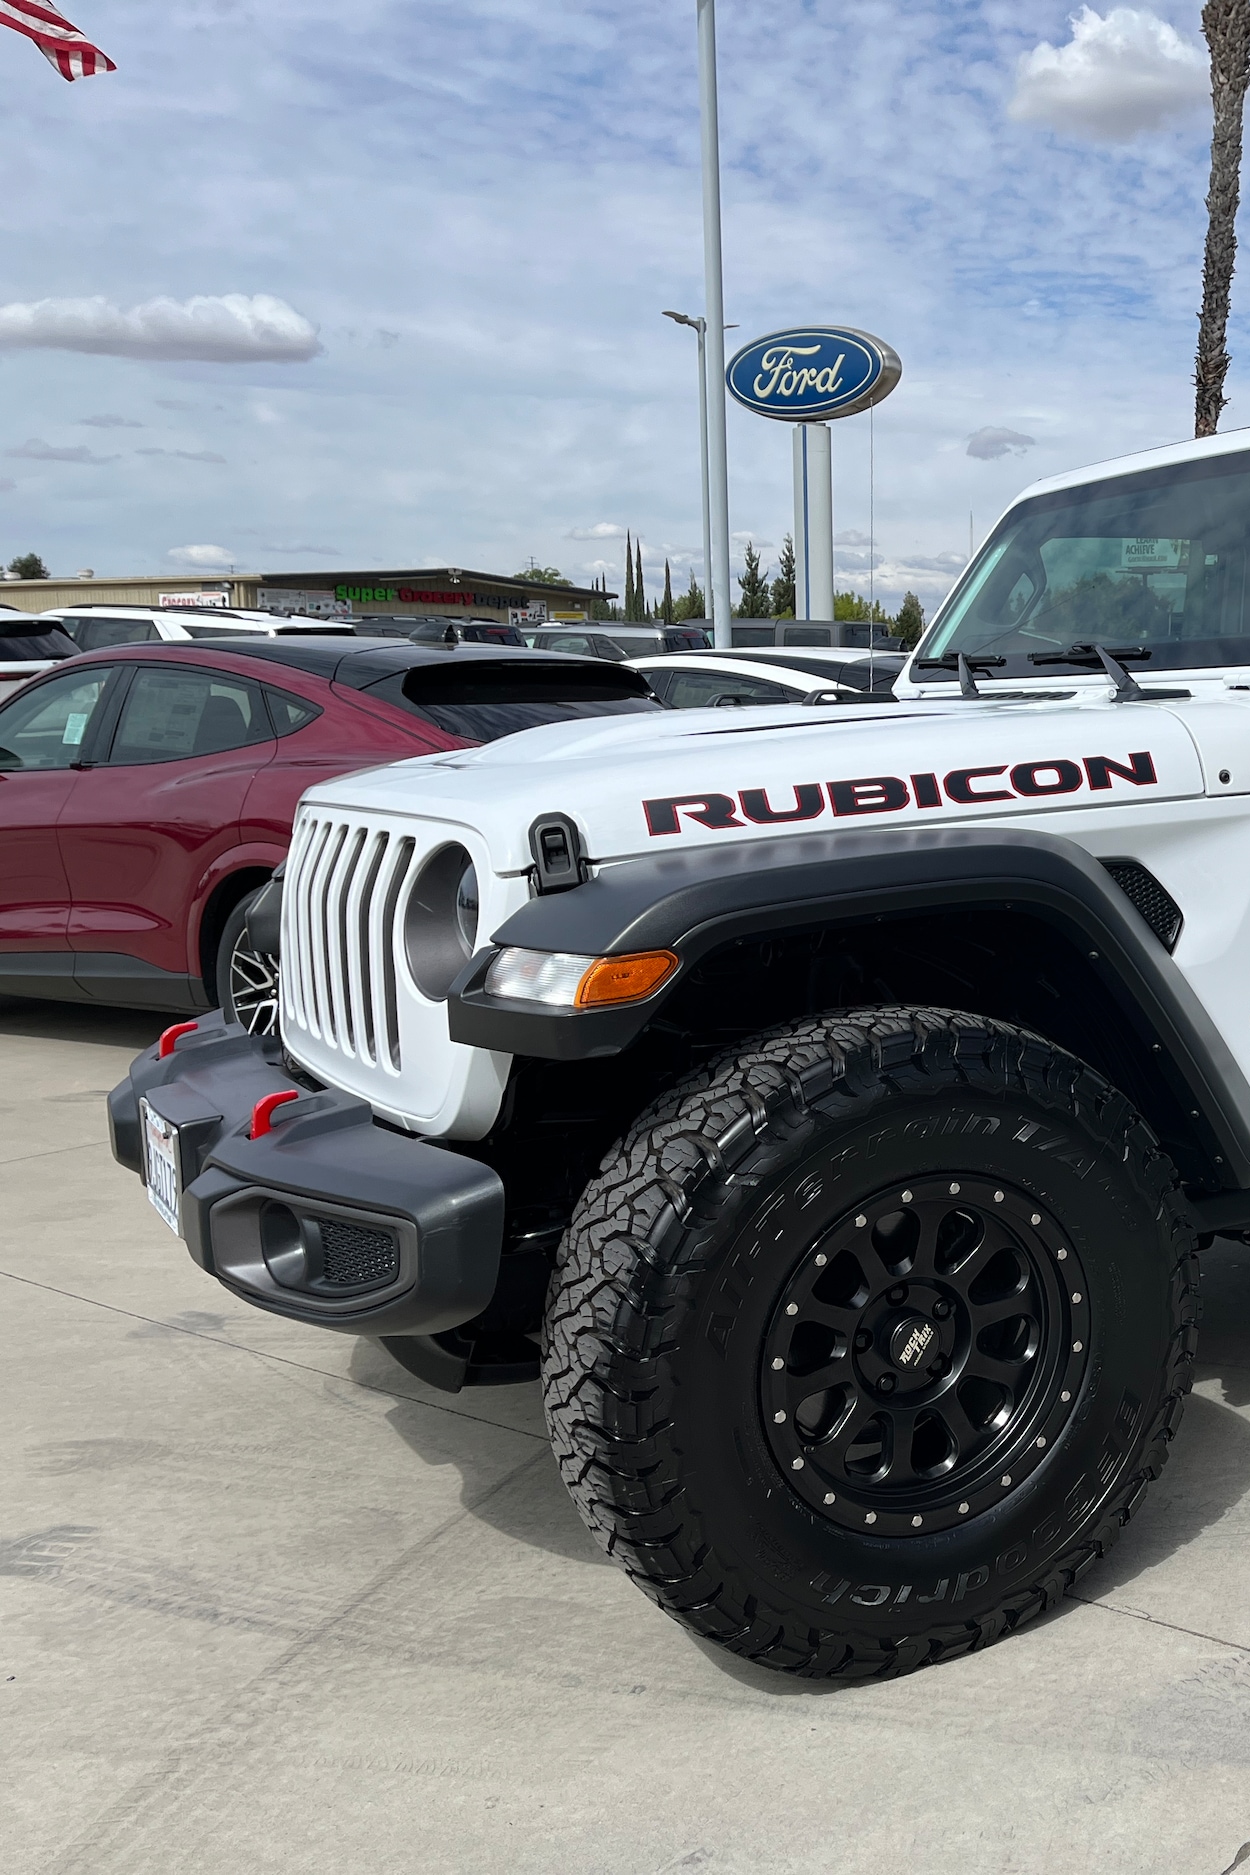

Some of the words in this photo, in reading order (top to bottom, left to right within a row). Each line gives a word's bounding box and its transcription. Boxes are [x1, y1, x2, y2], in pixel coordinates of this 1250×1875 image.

[753, 345, 846, 398] Ford
[1125, 545, 1155, 555] ACHIEVE
[336, 584, 394, 602] Super
[398, 587, 475, 606] Grocery
[642, 752, 1158, 836] RUBICON
